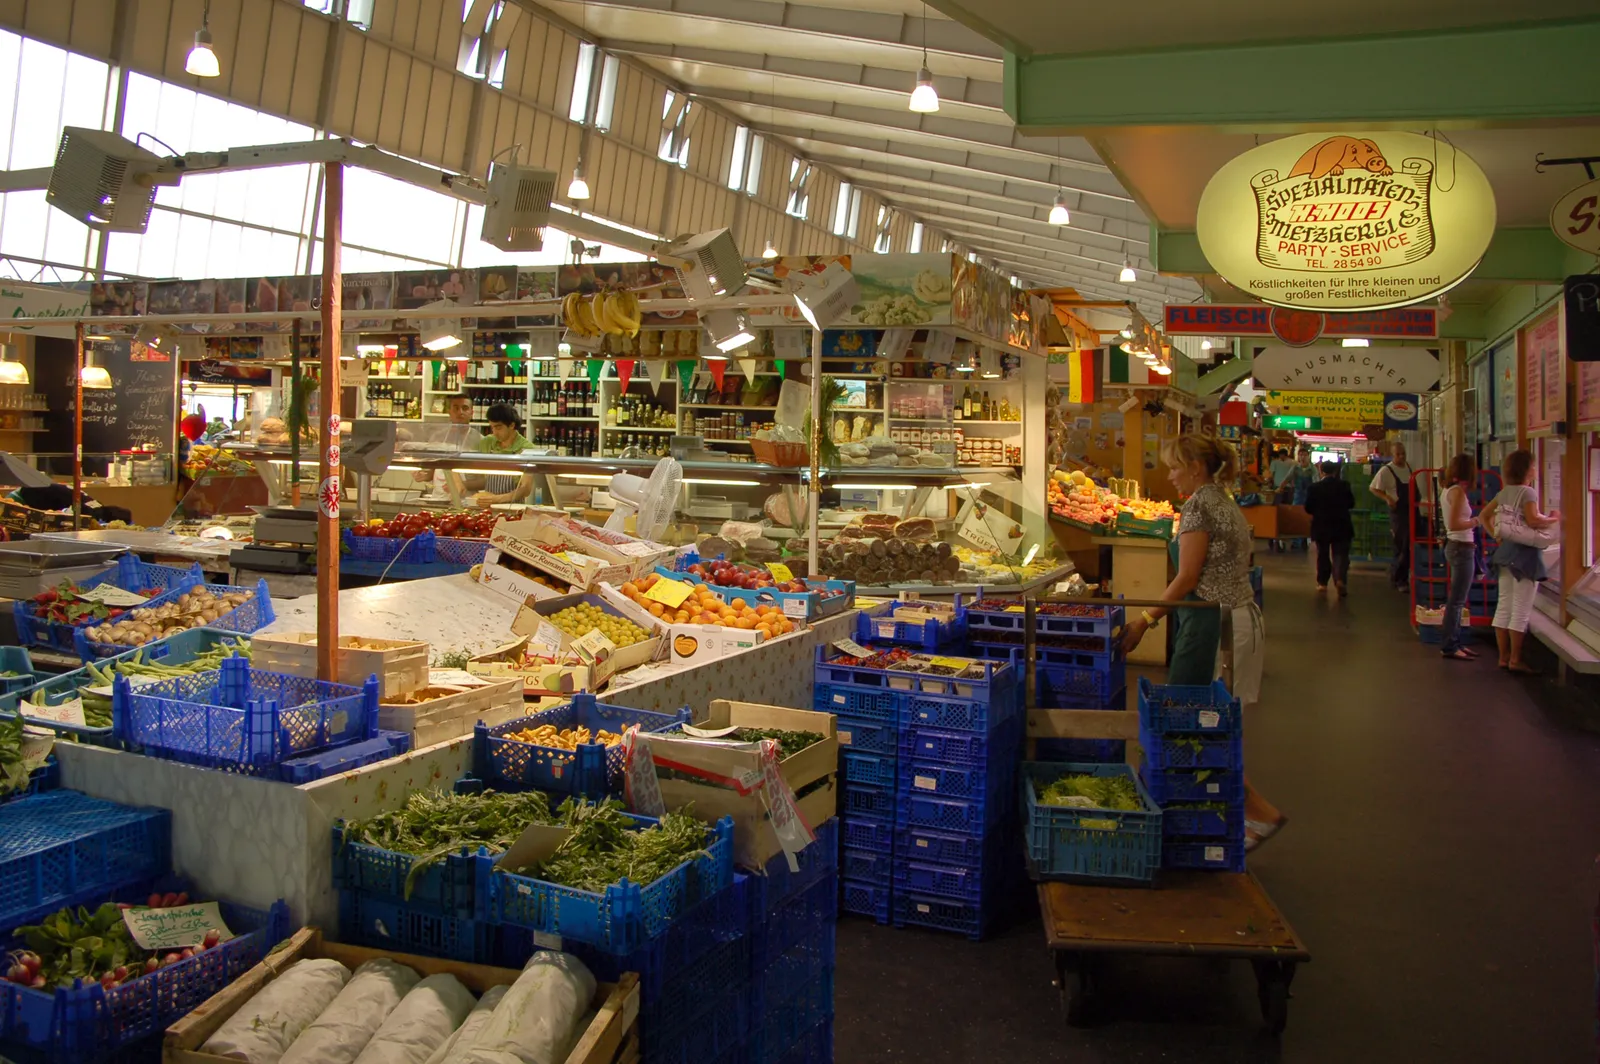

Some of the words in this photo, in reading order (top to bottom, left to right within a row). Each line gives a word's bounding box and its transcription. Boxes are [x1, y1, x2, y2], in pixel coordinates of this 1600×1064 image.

[1567, 195, 1600, 236] S
[1266, 210, 1398, 243] METZGEREI
[1278, 240, 1328, 257] PARTY
[1340, 232, 1411, 258] SERVICE
[1305, 259, 1329, 268] TEL.
[1333, 259, 1348, 269] 28
[1349, 258, 1365, 268] 54
[1367, 255, 1382, 266] 90
[1249, 279, 1326, 289] Köstlichkeiten
[1329, 277, 1345, 288] für
[1348, 277, 1369, 287] Ihre
[1373, 276, 1414, 286] kleinen
[1418, 275, 1441, 285] und
[1285, 289, 1324, 301] großen
[1169, 307, 1267, 324] FLEISCH
[1283, 354, 1407, 386] HAUSMACHER
[1312, 375, 1376, 385] WURST
[1282, 395, 1313, 404] HORST
[1316, 395, 1355, 405] FRANCK
[508, 538, 523, 553] Red
[521, 546, 538, 560] Star
[538, 554, 571, 575] Romantic
